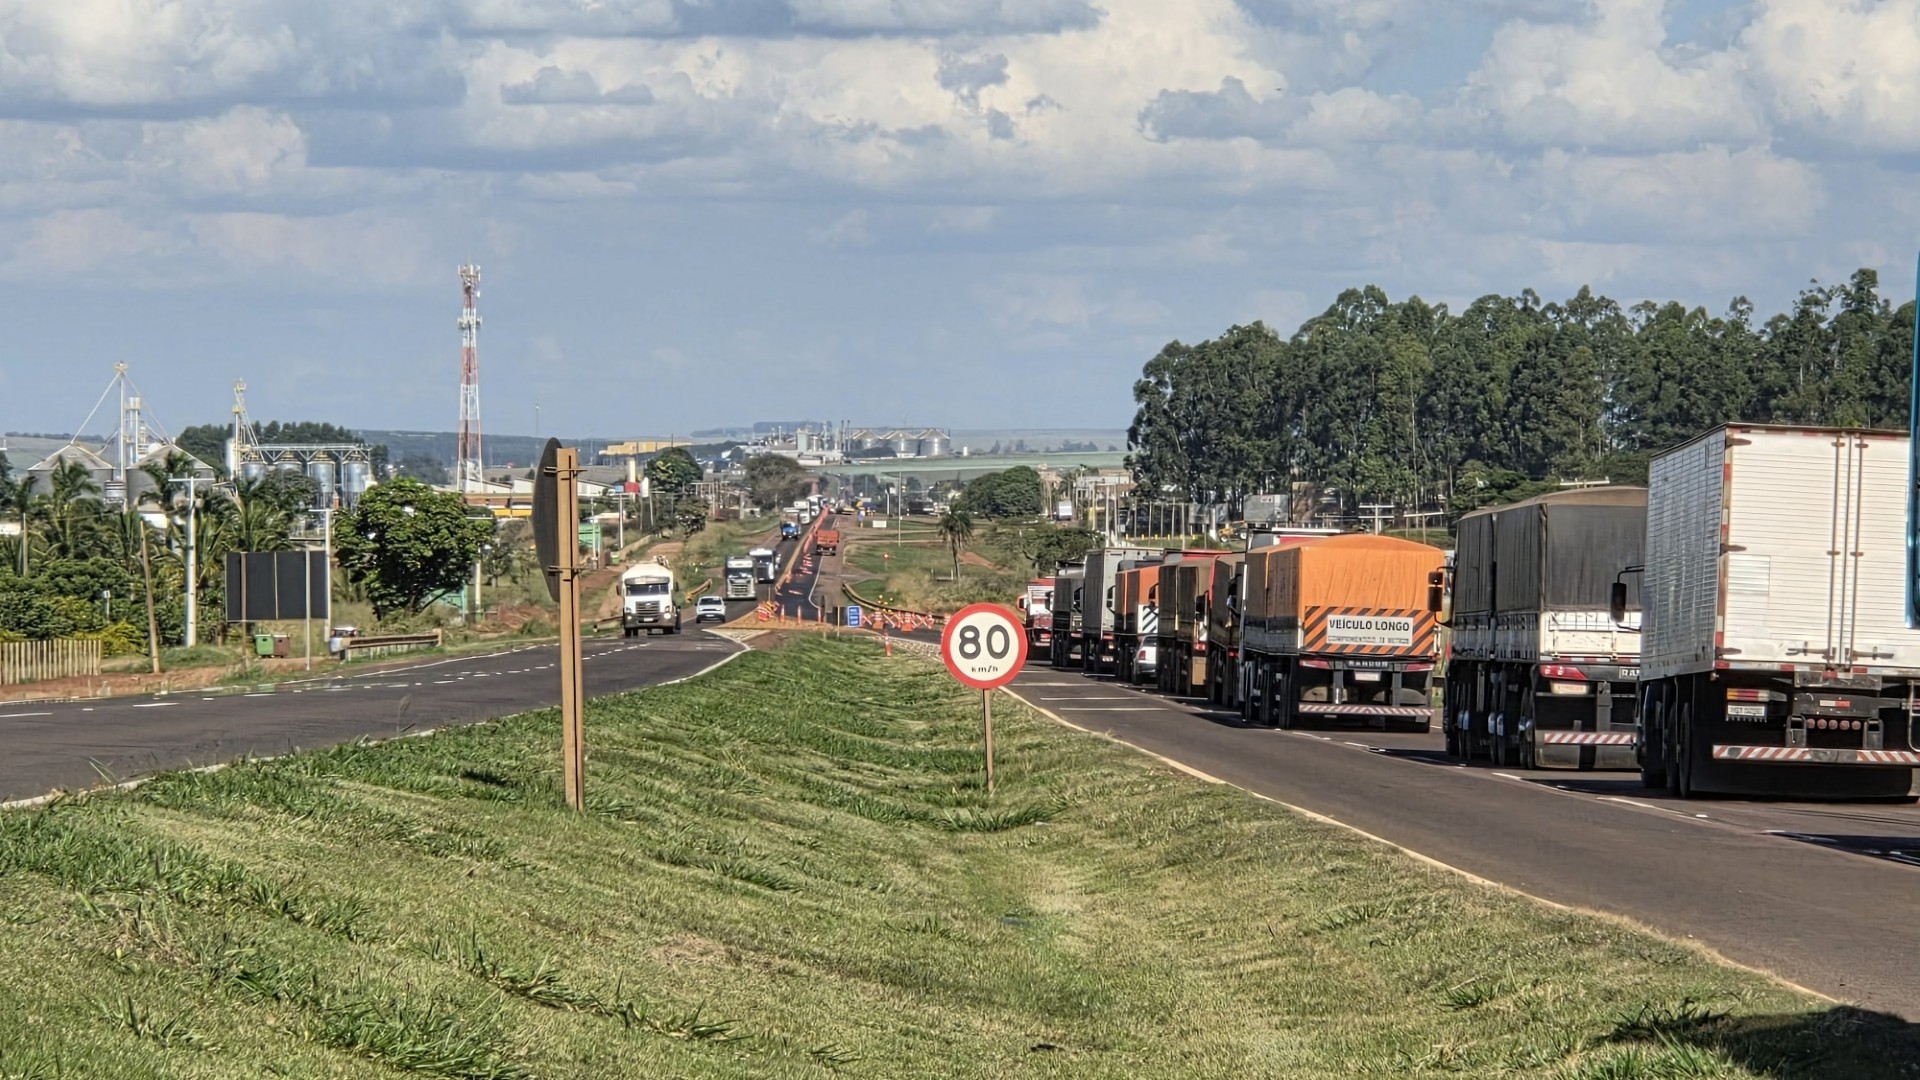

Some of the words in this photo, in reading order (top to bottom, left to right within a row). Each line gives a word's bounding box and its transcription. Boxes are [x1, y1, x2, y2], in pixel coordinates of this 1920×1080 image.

[1329, 619, 1372, 630] VEÍCULO
[1375, 620, 1410, 631] LONGO
[959, 624, 1010, 660] 80
[971, 665, 998, 673] km/h
